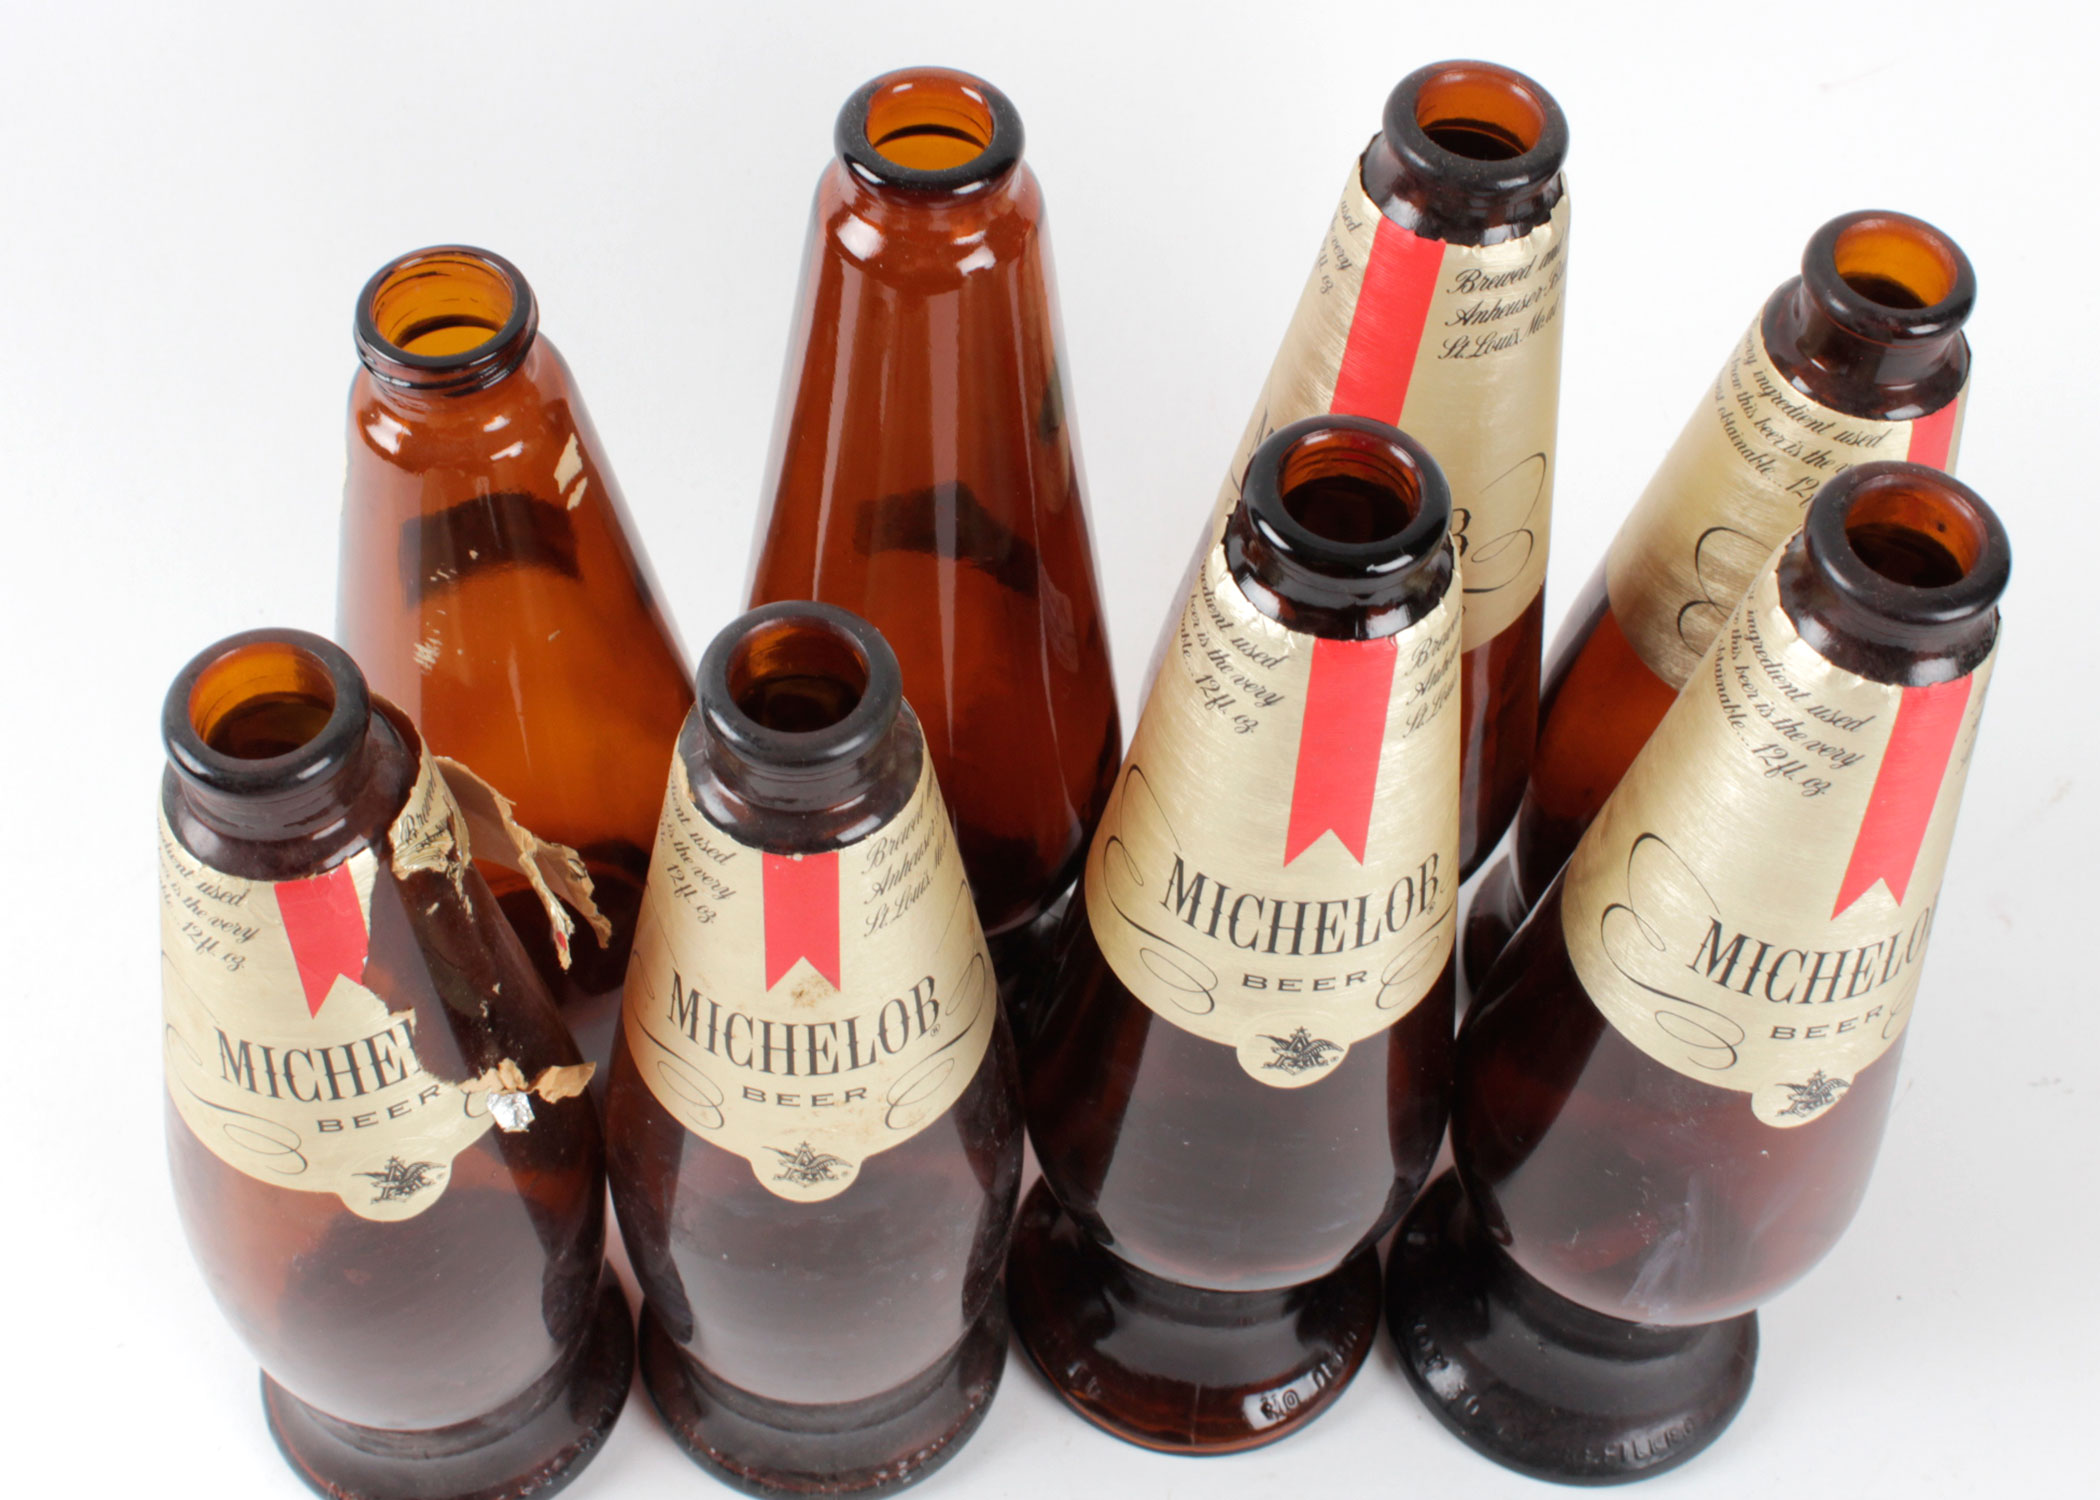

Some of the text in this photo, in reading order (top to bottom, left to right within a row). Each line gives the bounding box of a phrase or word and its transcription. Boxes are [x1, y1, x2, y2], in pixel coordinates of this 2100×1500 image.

[1446, 254, 1537, 295] Brewed
[1753, 367, 1837, 435] ingredient
[1832, 428, 1893, 448] used
[1736, 391, 1759, 420] this
[1754, 418, 1785, 446] beer
[1783, 440, 1804, 458] is
[1801, 449, 1835, 470] the
[1230, 636, 1289, 670] used
[1730, 628, 1744, 662] this
[1197, 631, 1209, 648] is
[1207, 649, 1233, 675] the
[1230, 673, 1285, 708] very
[1734, 664, 1758, 701] beer
[1745, 607, 1877, 733] ingredient used
[1754, 701, 1777, 718] is
[1771, 717, 1809, 743] the
[1802, 738, 1866, 770] very
[689, 831, 737, 866] used
[673, 840, 694, 866] the
[691, 865, 737, 901] very
[195, 881, 252, 907] used
[1159, 852, 1439, 957] MICHELOB
[182, 895, 208, 919] the
[207, 913, 261, 944] very
[1686, 894, 1937, 1005] MICHELO
[1241, 970, 1369, 993] BEER
[665, 967, 941, 1078] MICHELOB
[1769, 1004, 1884, 1040] BEER
[316, 1083, 441, 1133] BEER
[742, 1085, 869, 1108] BEER
